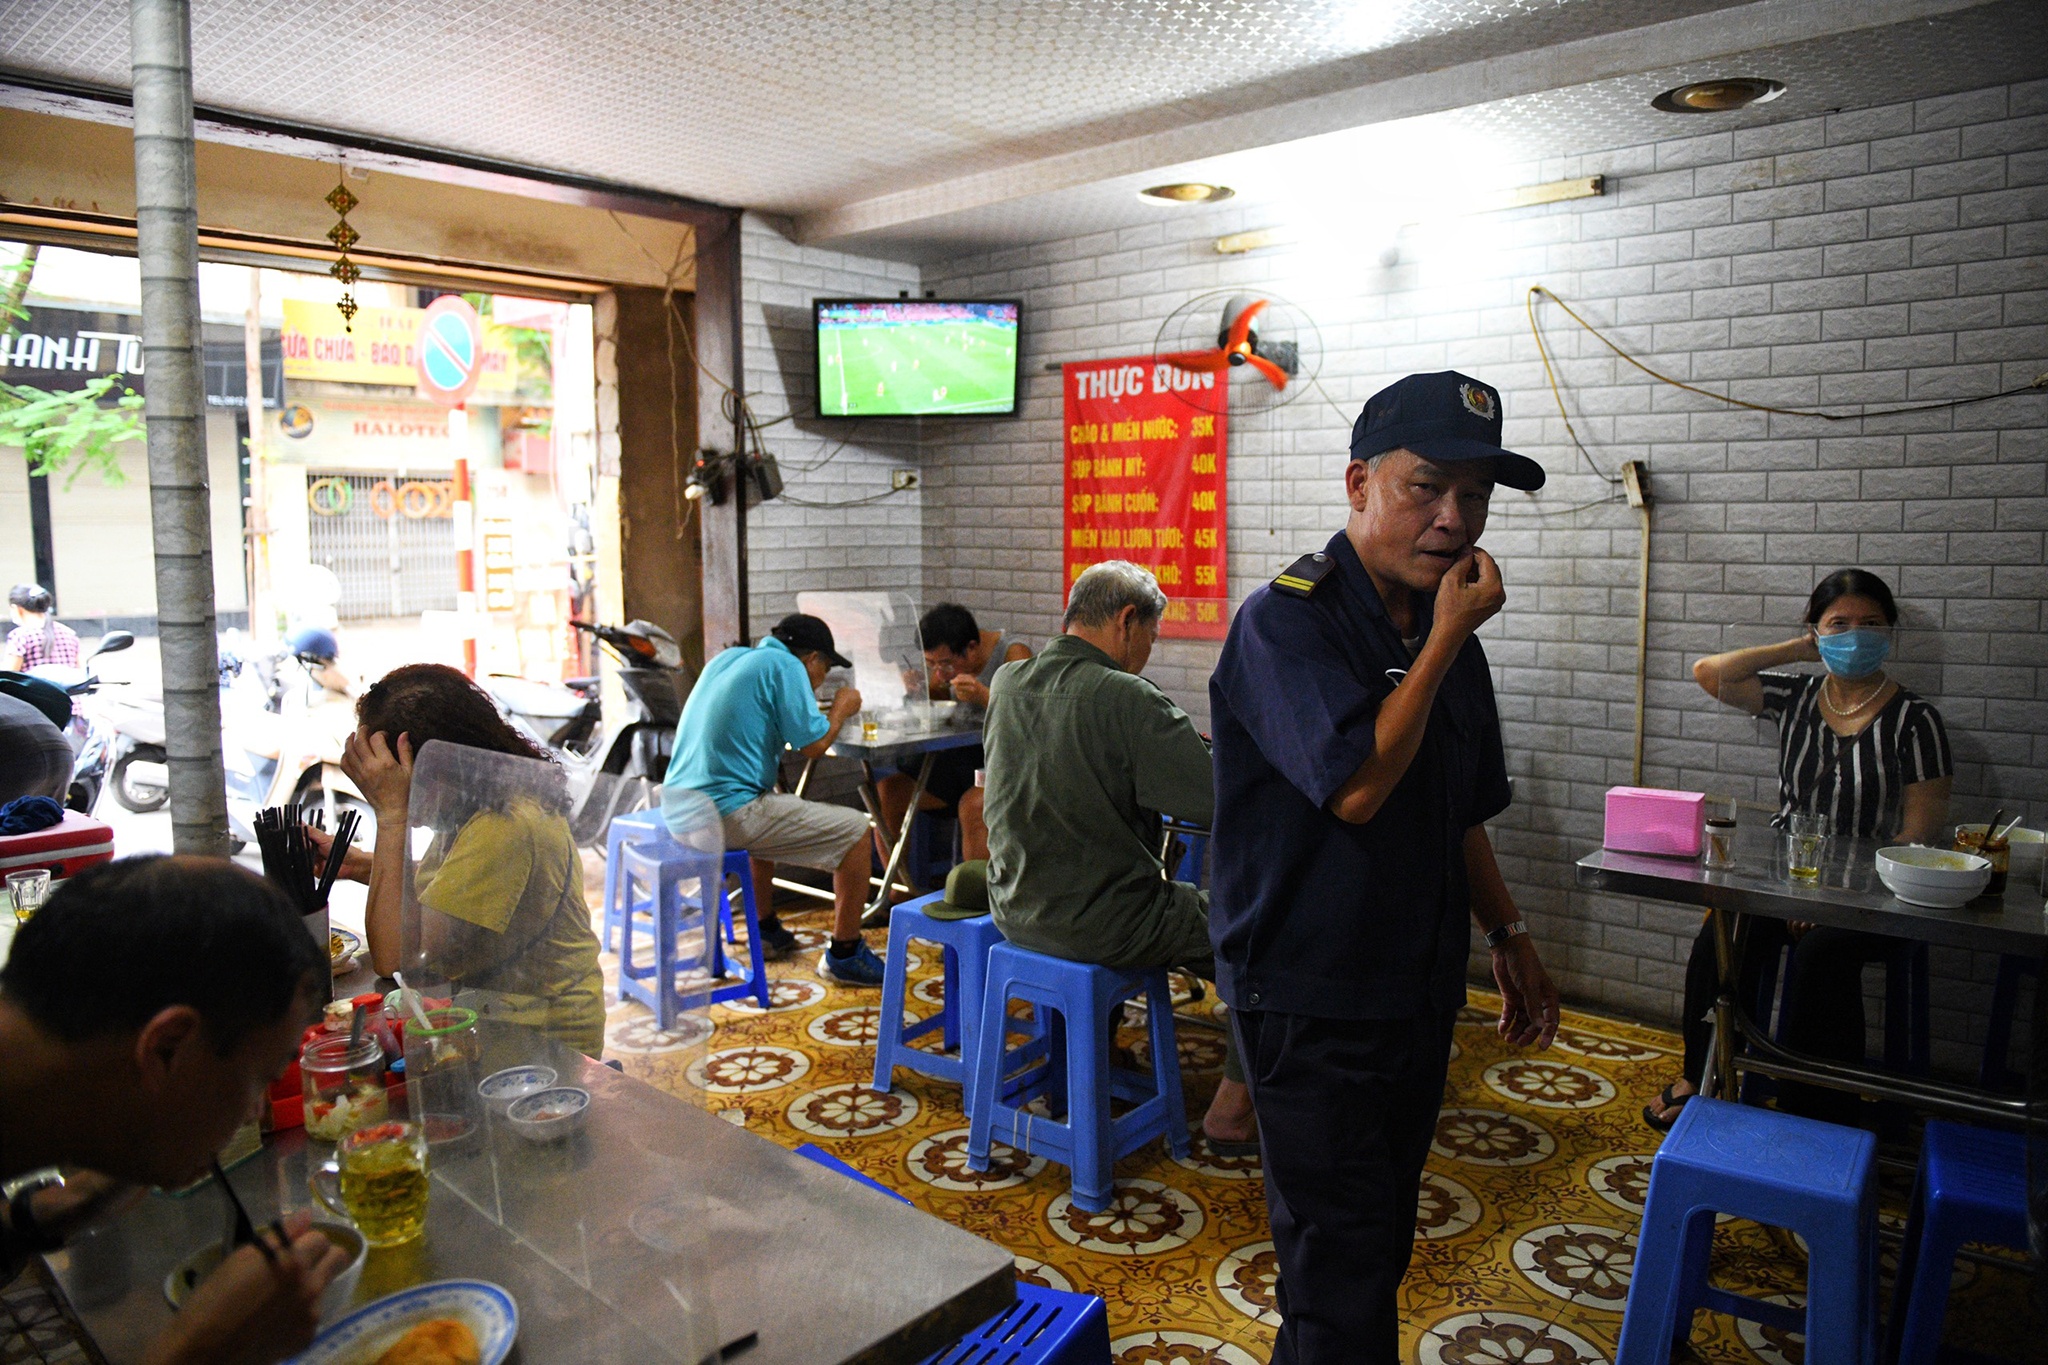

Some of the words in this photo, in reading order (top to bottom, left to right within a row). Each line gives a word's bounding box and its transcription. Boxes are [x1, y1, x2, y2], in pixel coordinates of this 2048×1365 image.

[1075, 364, 1144, 403] THỰC
[1190, 414, 1216, 438] 35K
[1191, 452, 1217, 475] 40K
[1191, 490, 1217, 512] 40K
[1194, 527, 1218, 549] 45K
[1195, 564, 1217, 586] 55K
